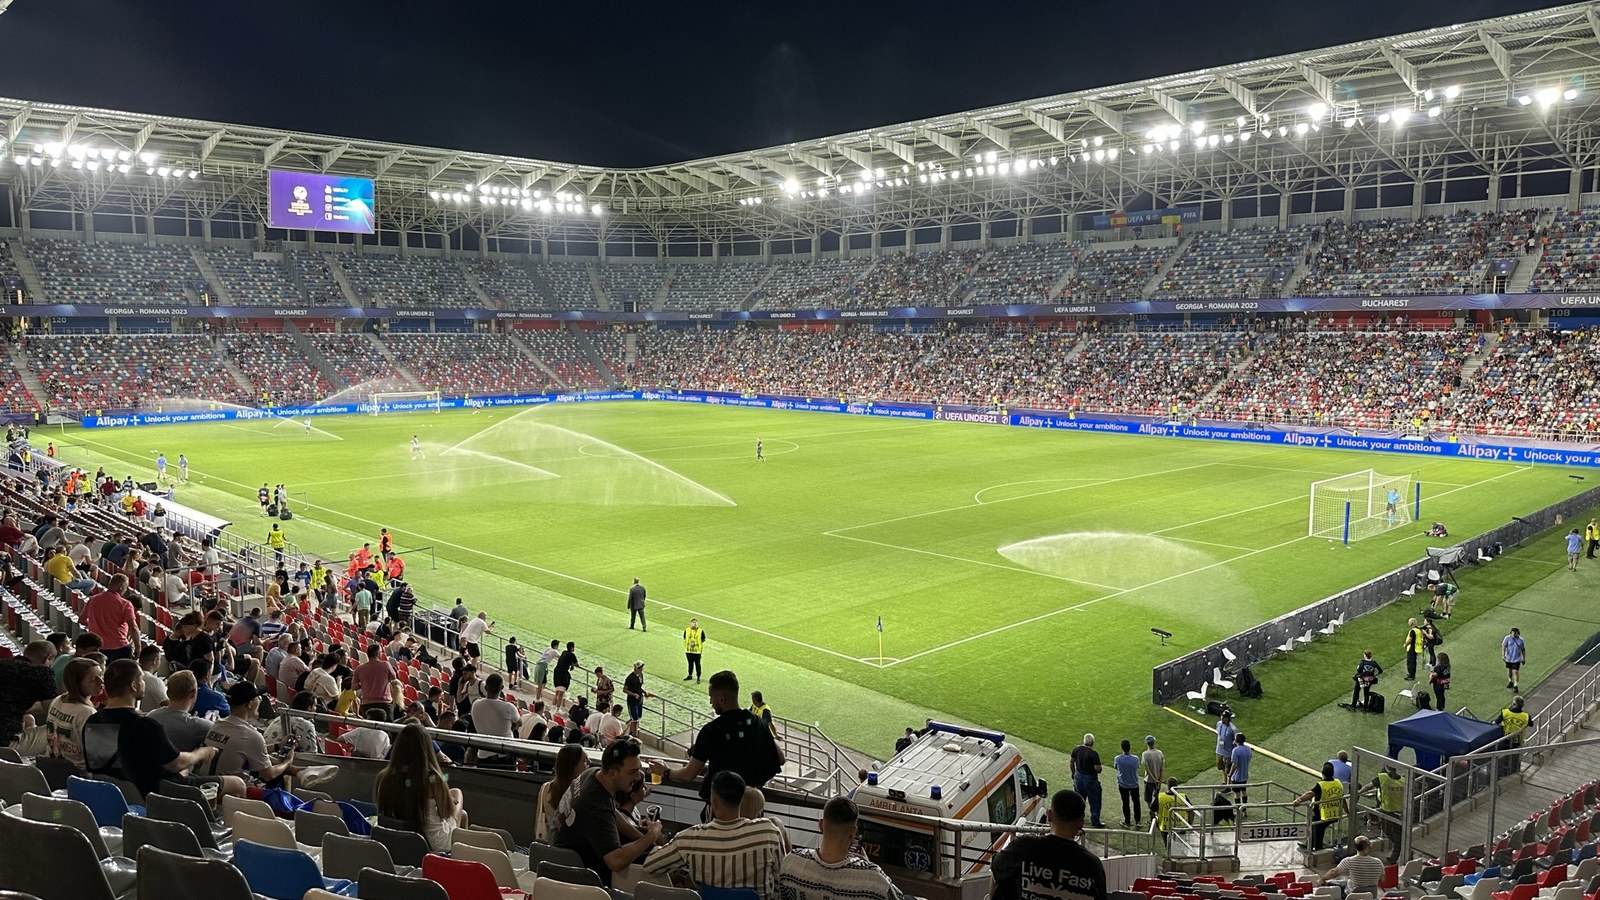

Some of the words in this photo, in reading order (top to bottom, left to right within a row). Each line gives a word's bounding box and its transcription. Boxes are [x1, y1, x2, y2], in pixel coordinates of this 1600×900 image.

[945, 413, 963, 421] UEFA
[1095, 422, 1128, 431] ambitions
[1183, 428, 1210, 437] Unlock
[1231, 431, 1271, 441] ambitions
[1337, 438, 1368, 448] Unlock
[1370, 441, 1391, 450] your
[1393, 442, 1441, 453] ambitions
[1524, 451, 1562, 461] Unlock
[1565, 454, 1591, 464] your
[1022, 861, 1052, 880] Live
[1058, 869, 1092, 890] Fast
